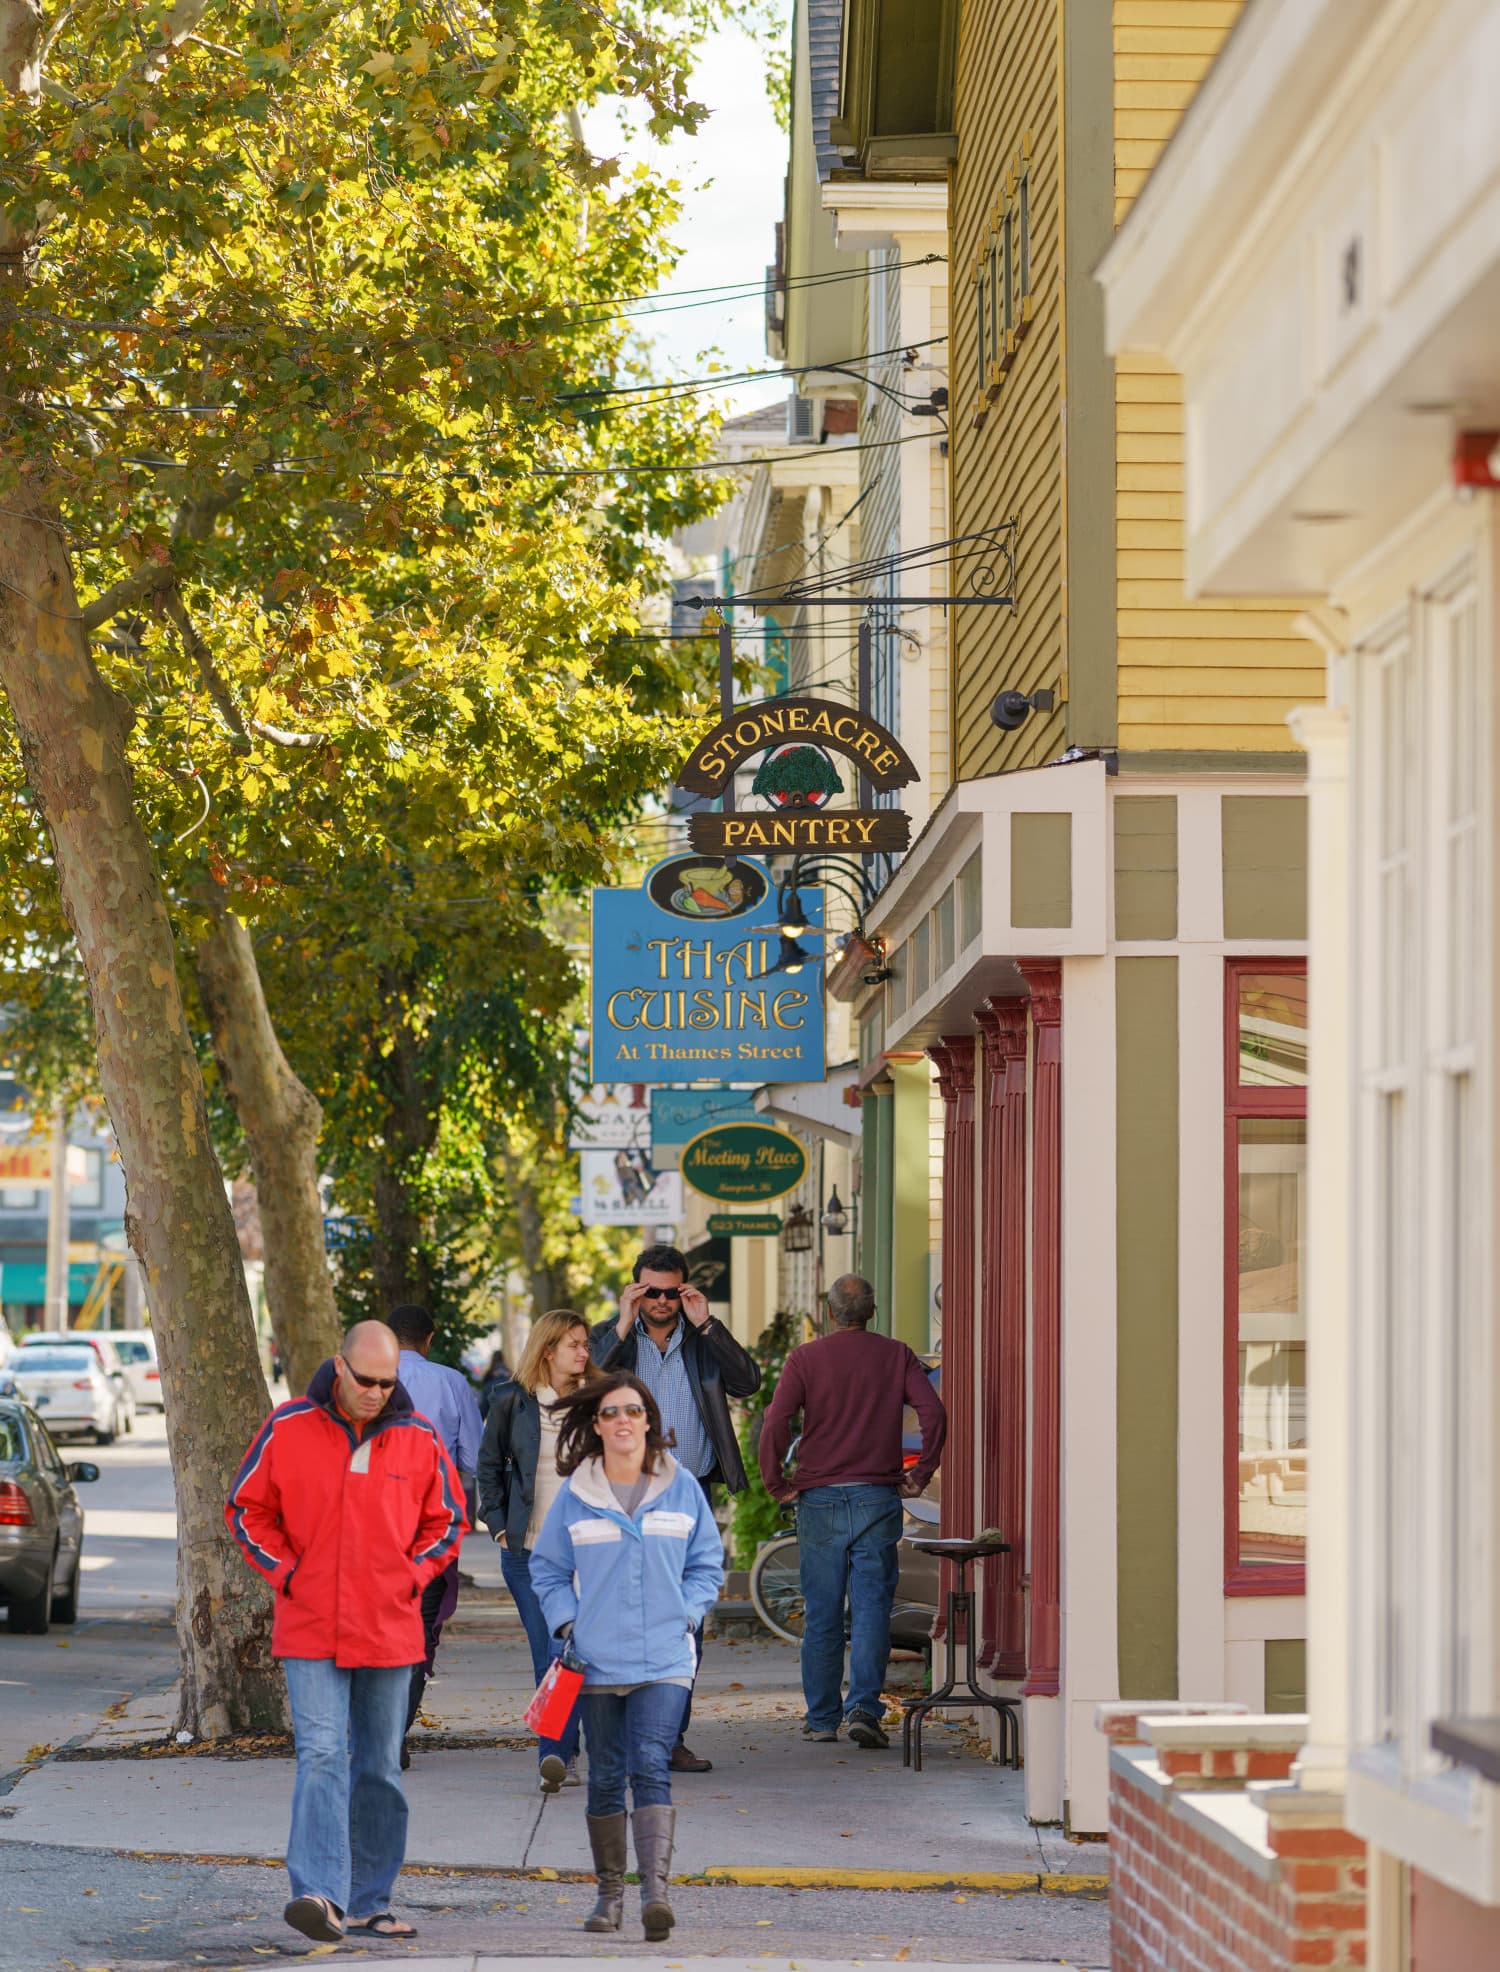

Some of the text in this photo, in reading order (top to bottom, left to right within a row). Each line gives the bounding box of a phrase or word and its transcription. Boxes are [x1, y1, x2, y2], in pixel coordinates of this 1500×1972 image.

[699, 707, 900, 780] STONEACRE
[722, 817, 880, 847] PANTRY
[647, 937, 769, 987] THAI
[607, 987, 809, 1031] CUISINE
[616, 1042, 804, 1060] At Thames Street
[689, 1148, 751, 1170] Meeting
[755, 1146, 800, 1166] Place
